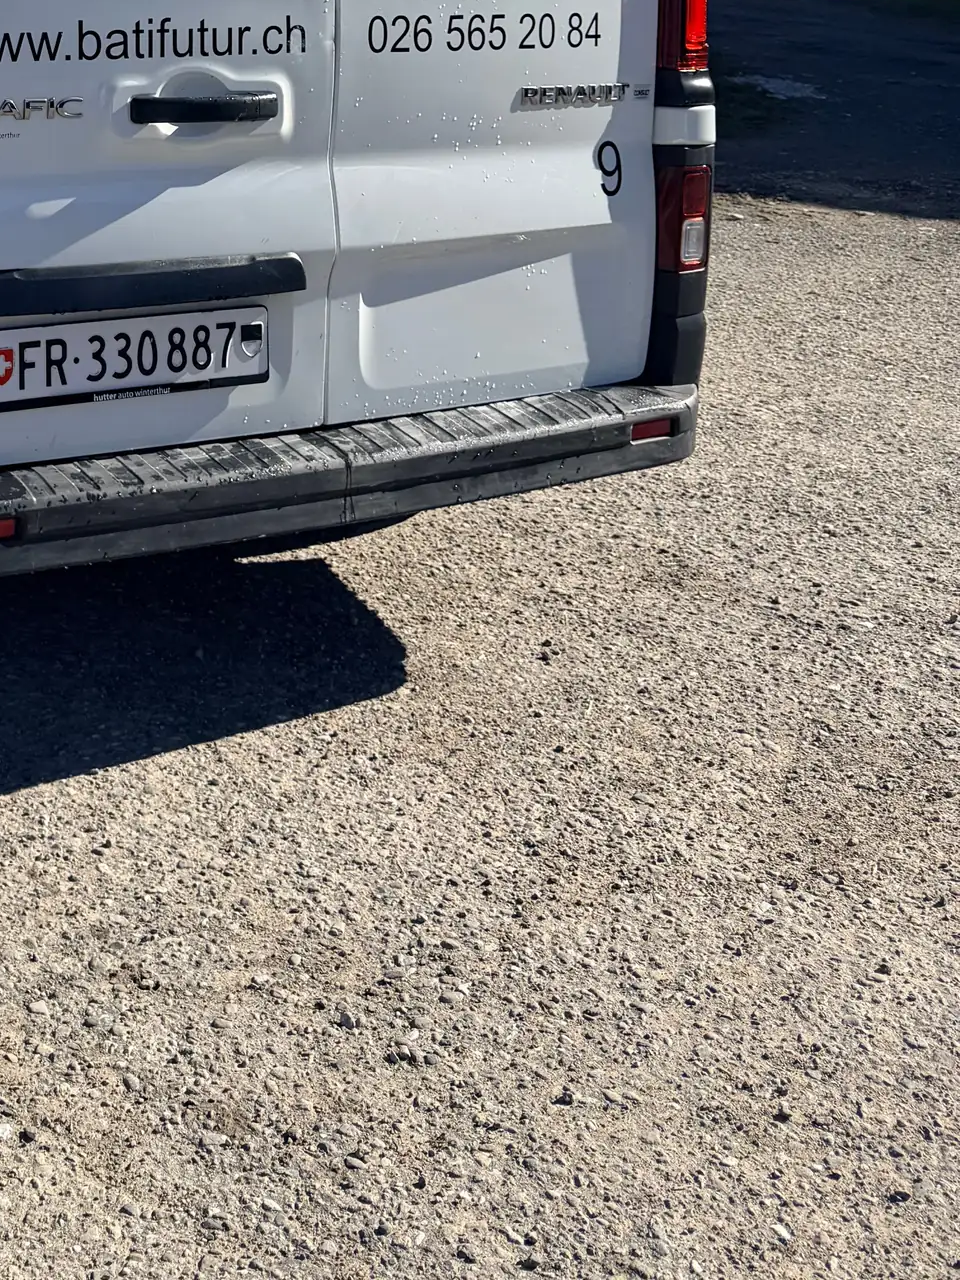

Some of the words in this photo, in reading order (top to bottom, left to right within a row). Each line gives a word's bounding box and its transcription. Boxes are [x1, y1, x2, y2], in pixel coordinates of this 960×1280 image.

[368, 14, 433, 53] 026
[446, 14, 507, 52] 565
[518, 12, 555, 49] 20
[567, 12, 601, 48] 84
[520, 83, 630, 106] RENAULT
[597, 140, 622, 196] 9
[93, 392, 117, 402] hutter
[118, 390, 134, 400] auto
[135, 387, 171, 397] winterthur
